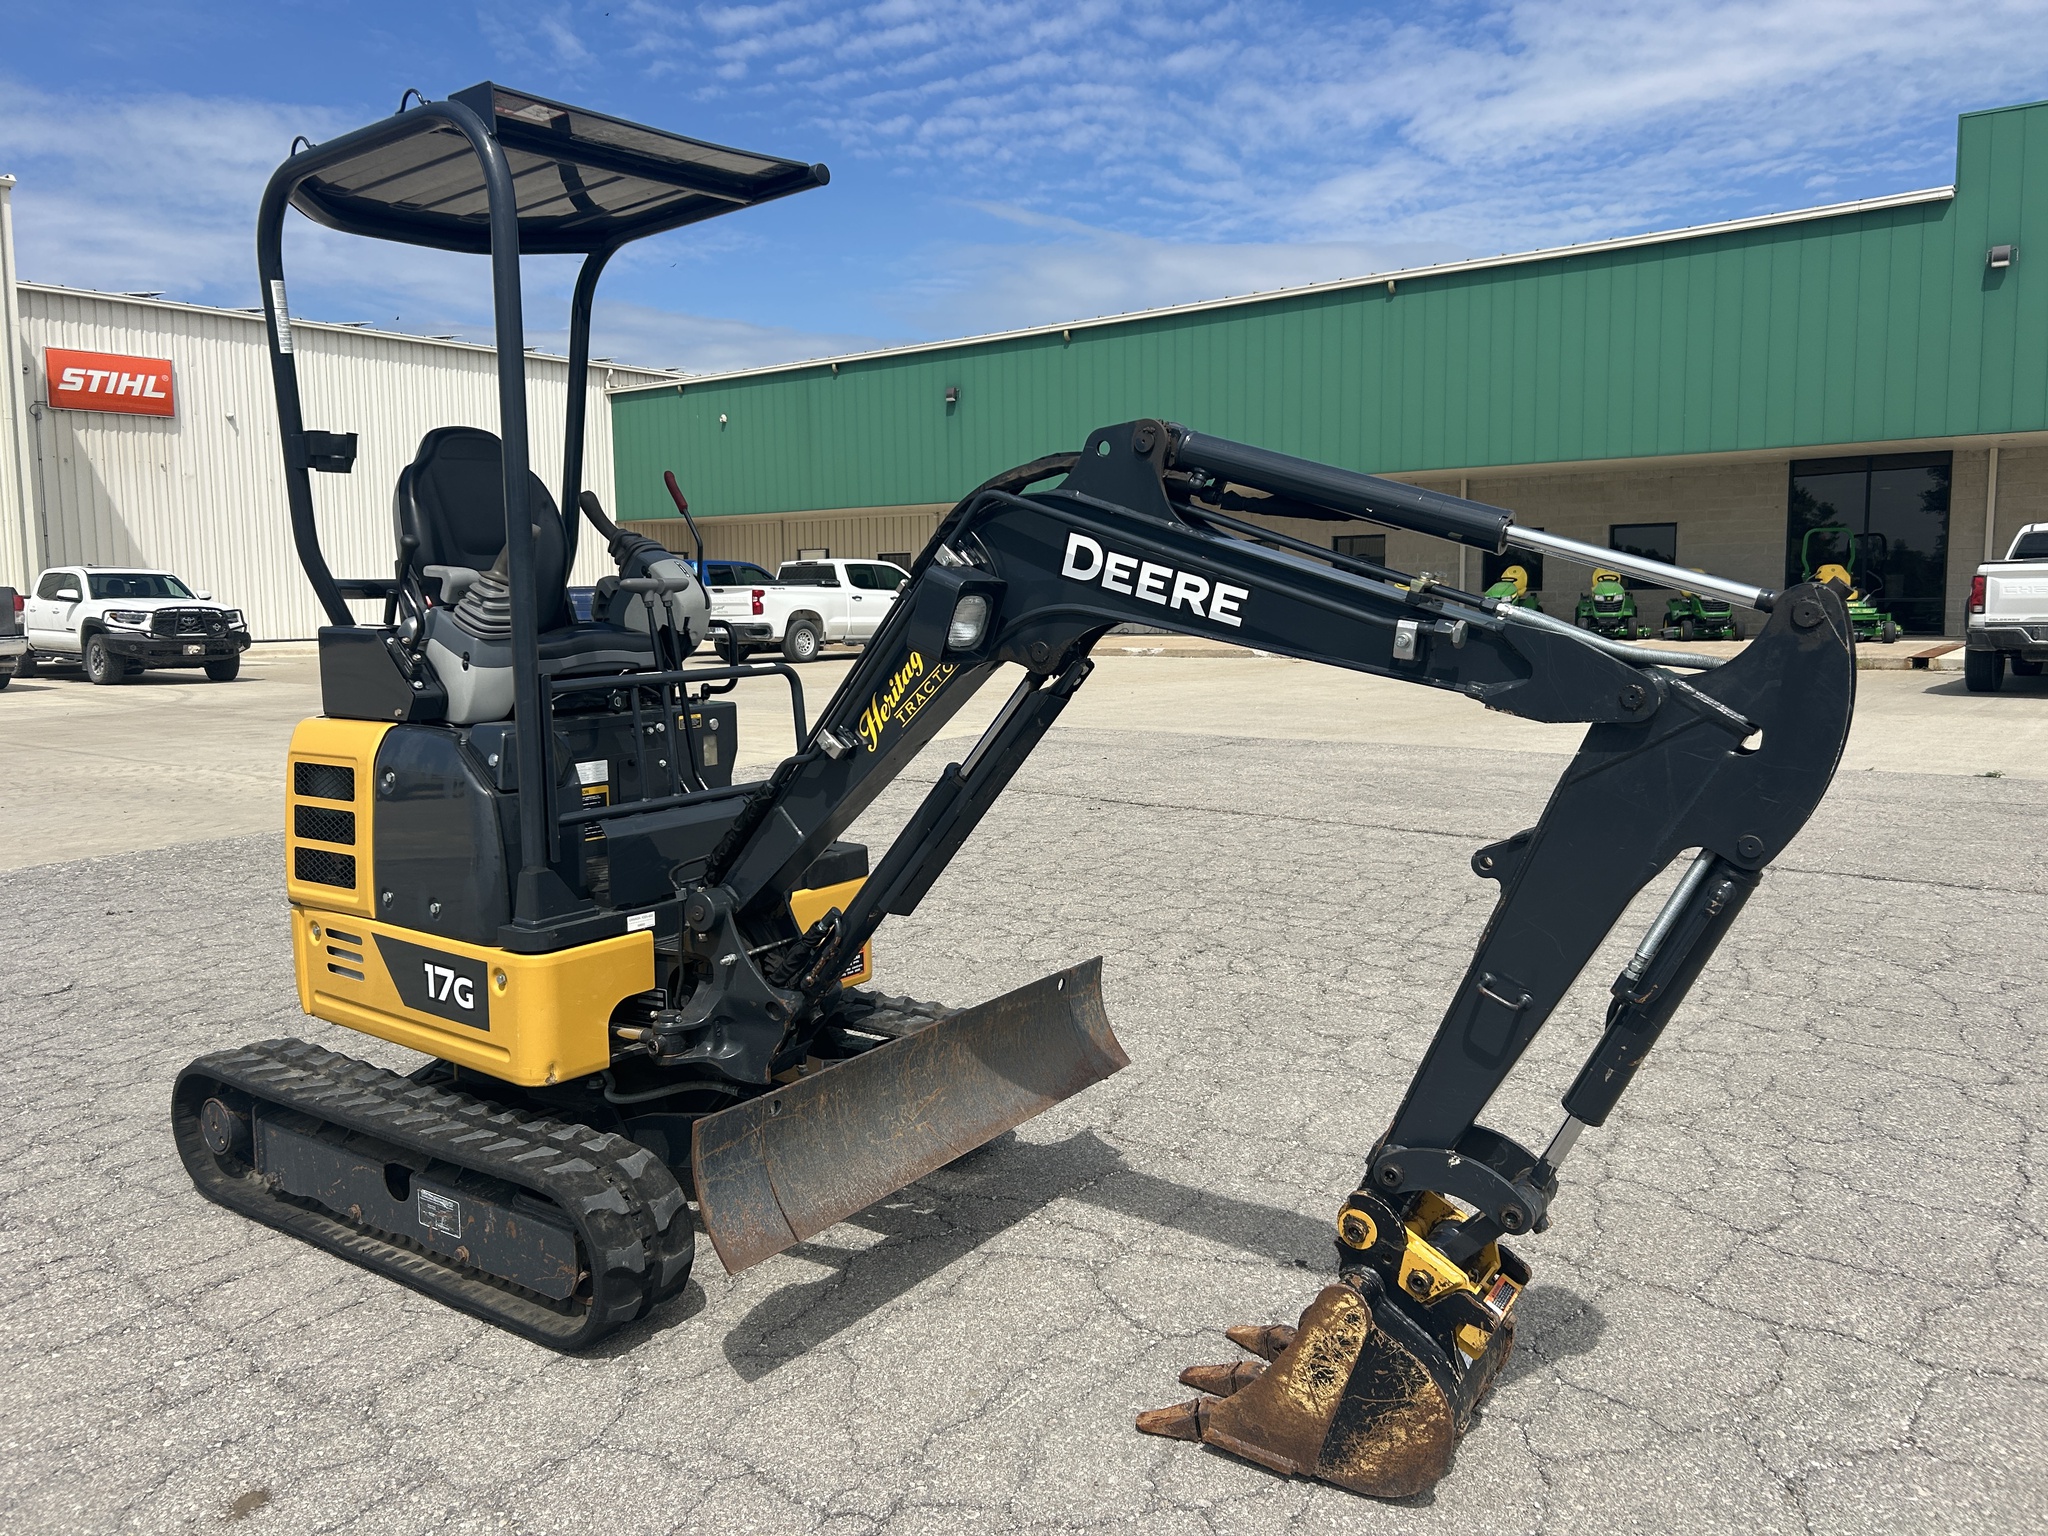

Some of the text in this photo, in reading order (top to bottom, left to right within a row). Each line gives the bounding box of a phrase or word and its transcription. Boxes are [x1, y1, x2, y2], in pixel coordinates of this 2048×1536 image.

[58, 367, 166, 399] STIHL
[1061, 532, 1250, 628] DEERE
[424, 962, 475, 1010] 17G
